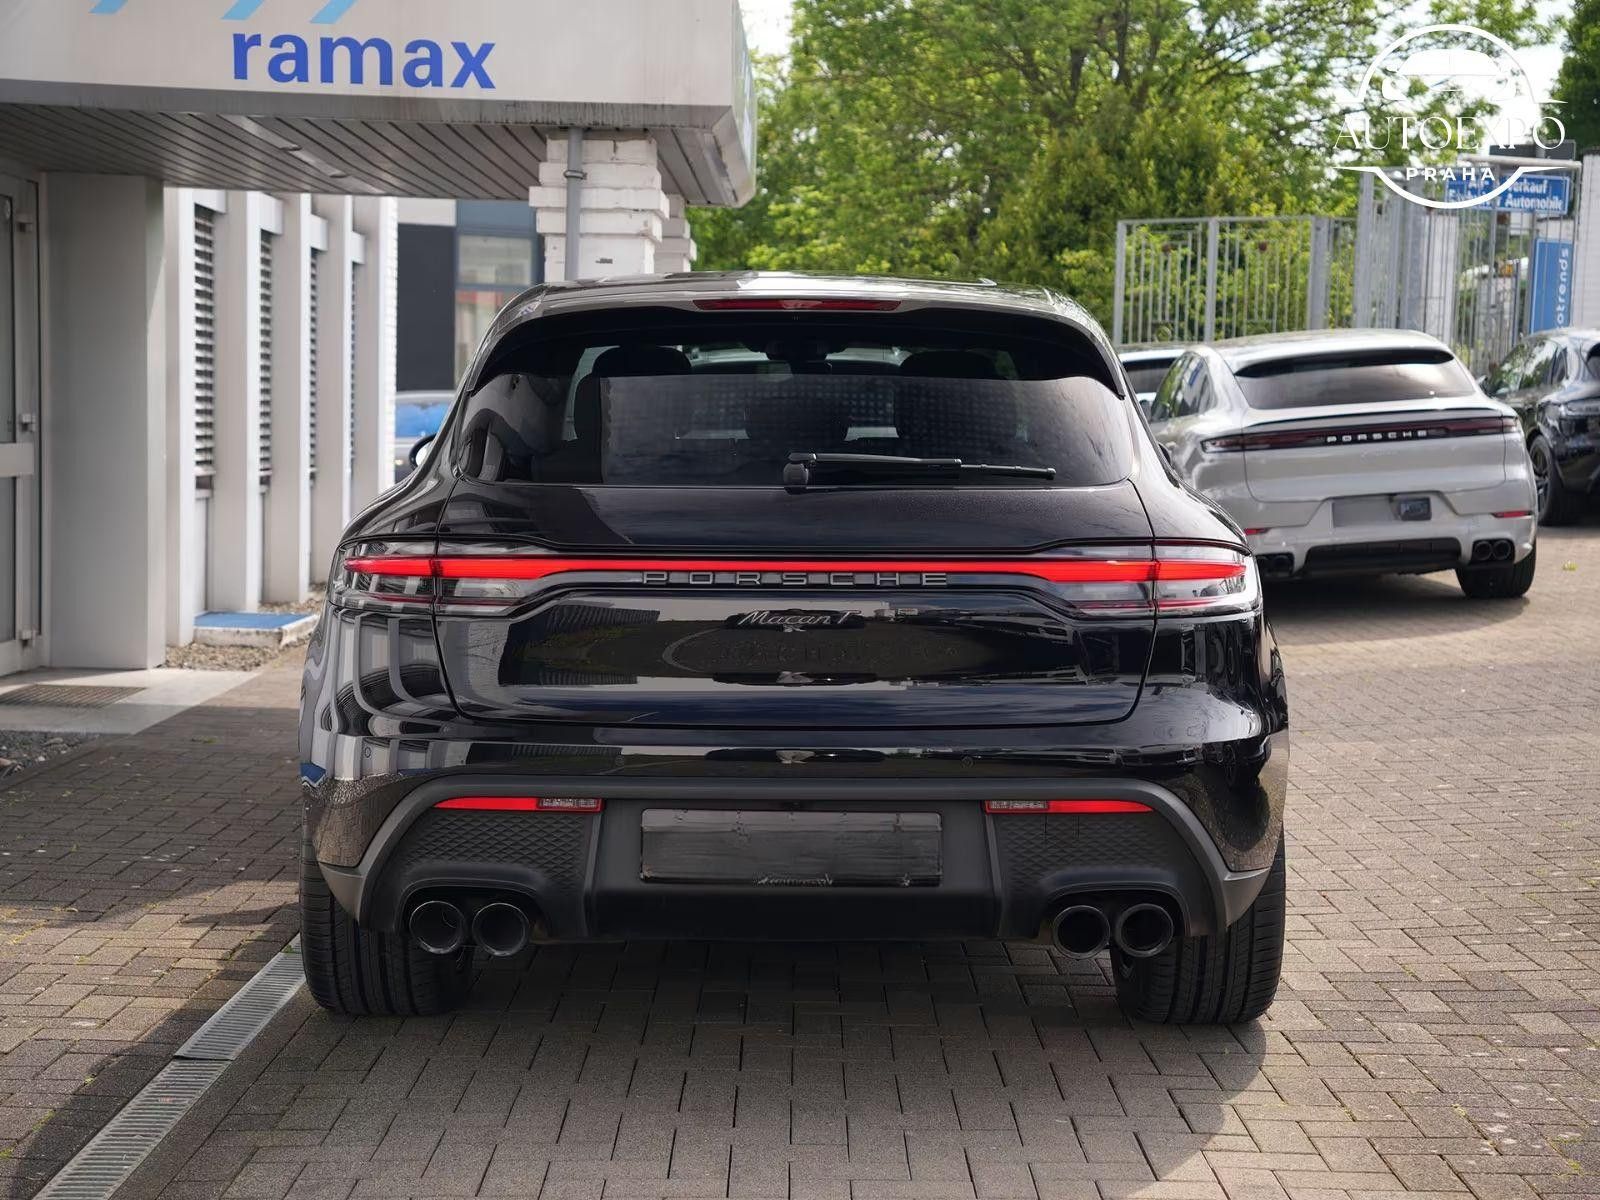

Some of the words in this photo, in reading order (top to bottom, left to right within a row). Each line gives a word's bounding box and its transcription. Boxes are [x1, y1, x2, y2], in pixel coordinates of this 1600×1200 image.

[233, 33, 496, 89] ramax
[1326, 430, 1427, 442] PORSCHE
[643, 571, 948, 586] PORSCHE
[738, 609, 830, 625] Macan
[837, 609, 863, 625] T
